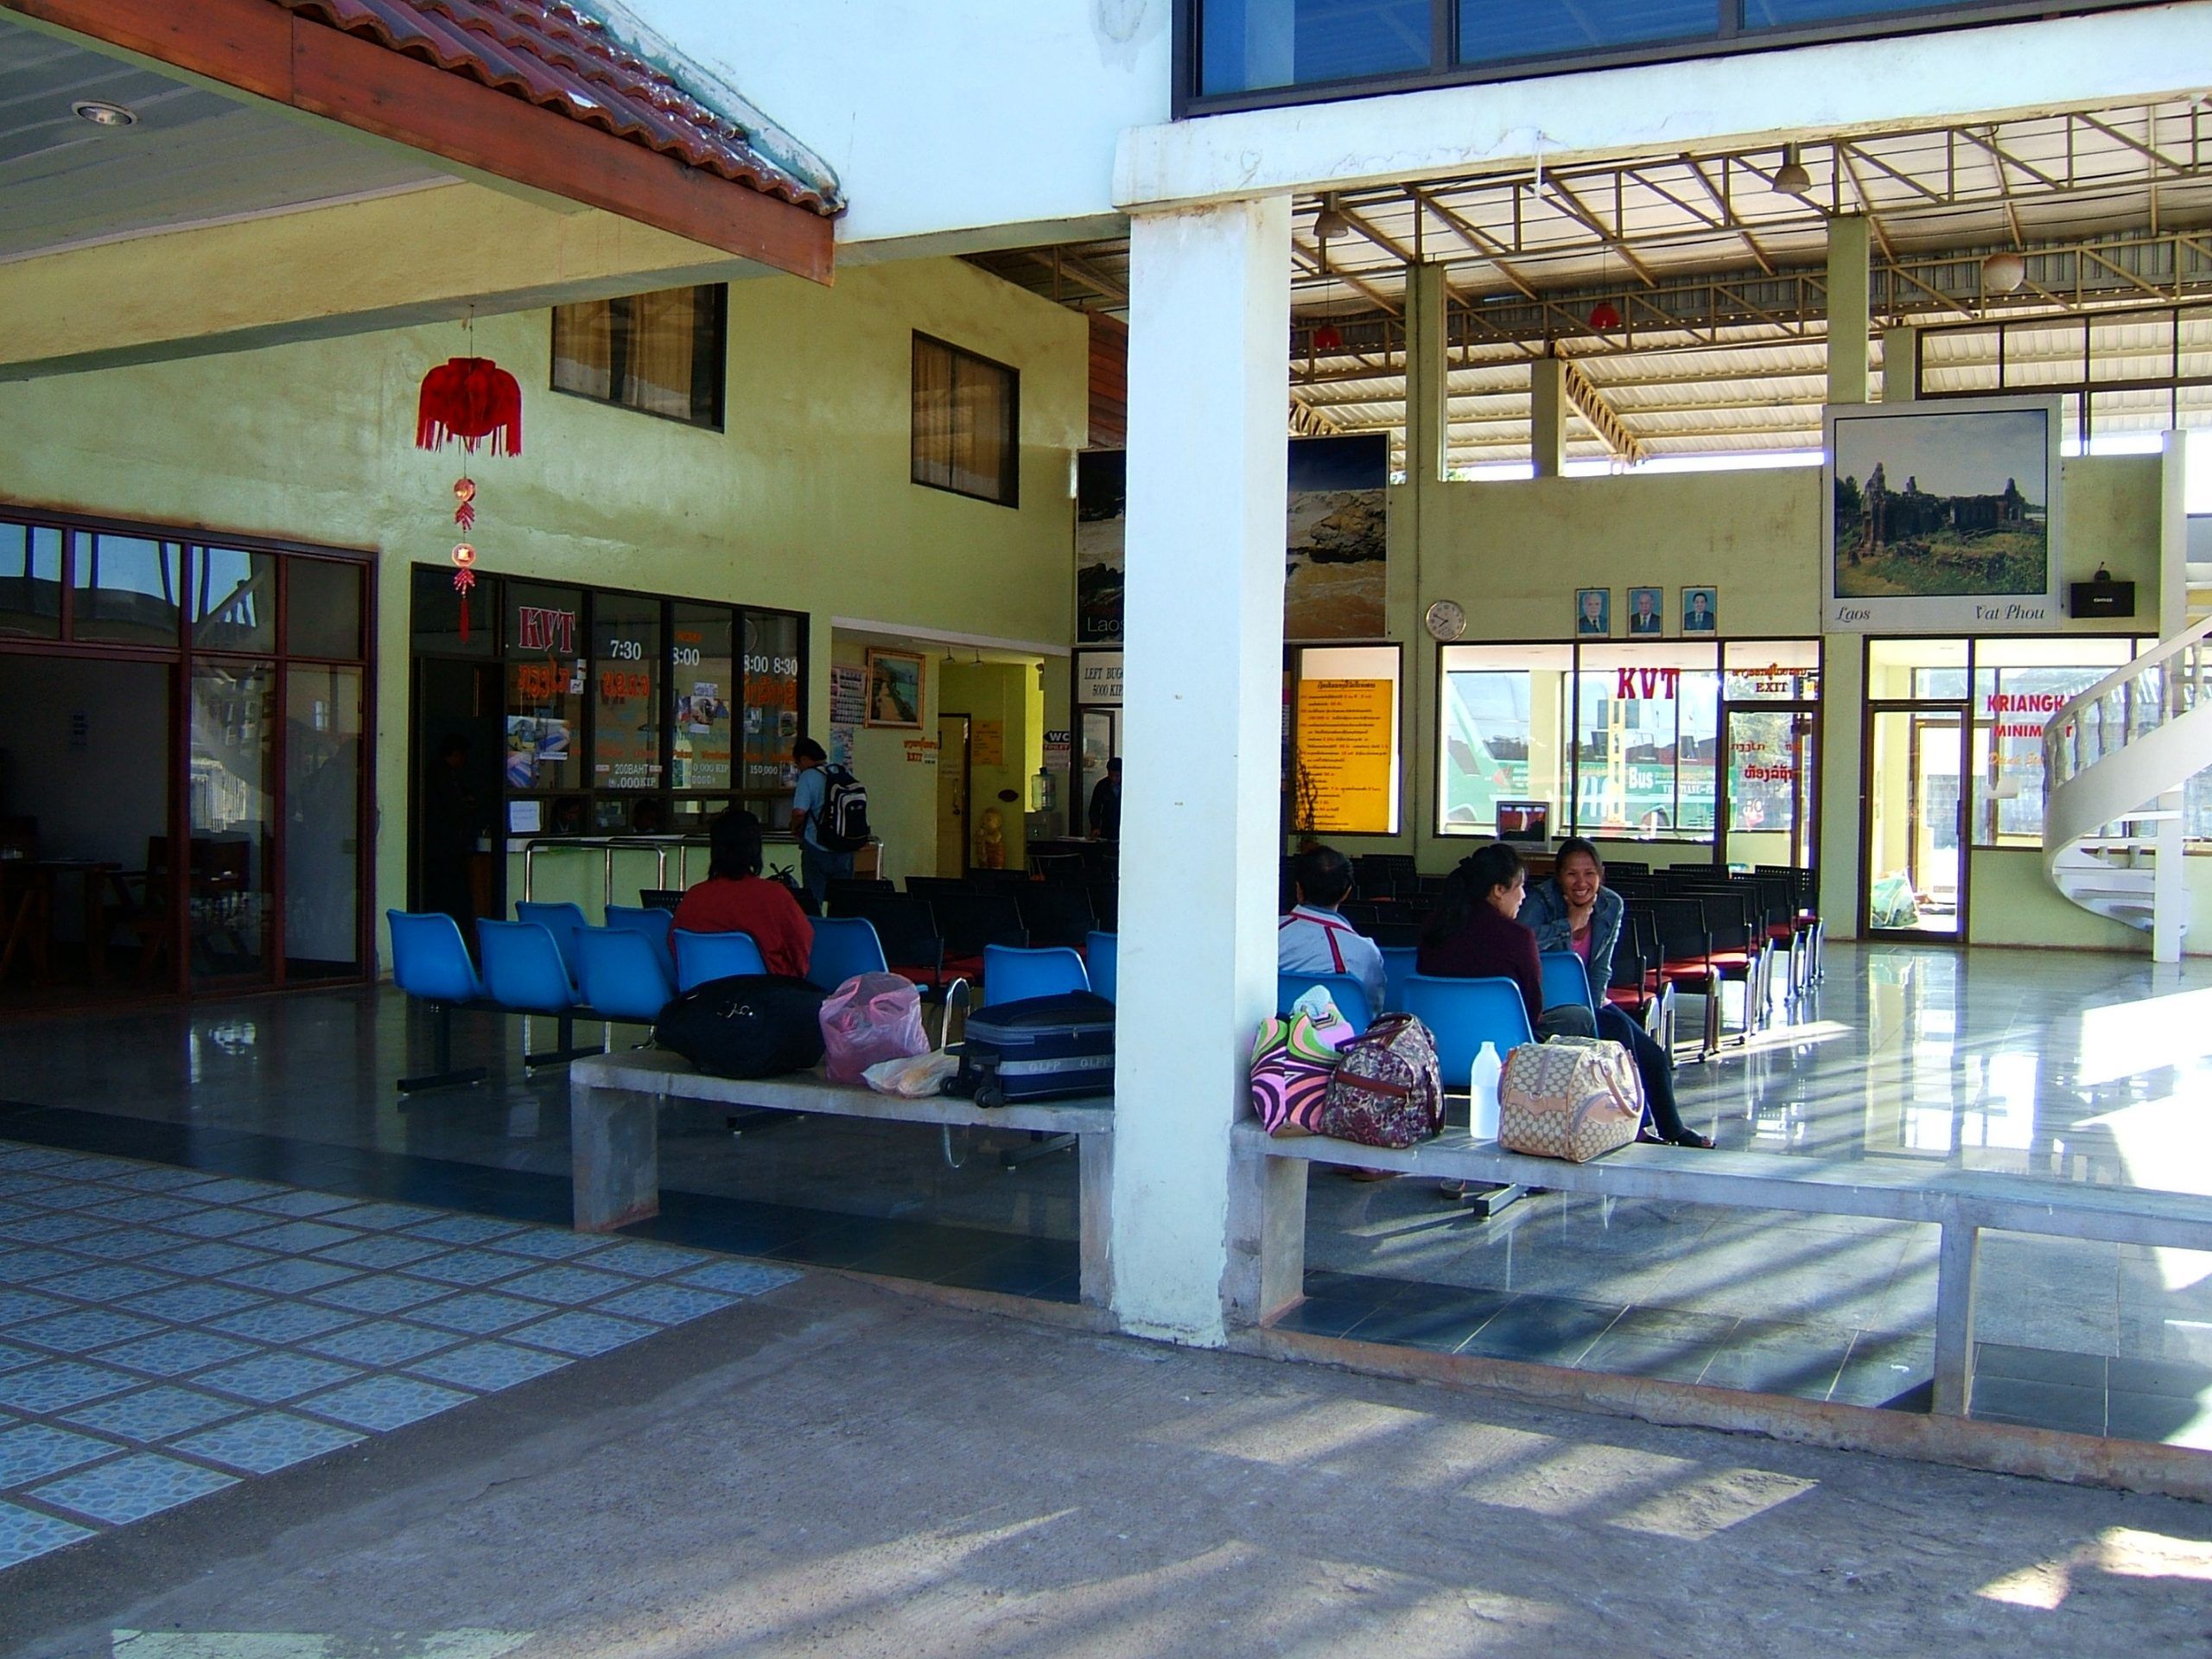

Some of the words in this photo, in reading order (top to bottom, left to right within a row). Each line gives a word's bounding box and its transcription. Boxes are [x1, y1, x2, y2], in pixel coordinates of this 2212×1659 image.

[1834, 607, 1871, 623] Laos
[1976, 605, 2000, 620] Vat
[2004, 604, 2045, 620] Phou
[518, 606, 576, 652] KVT
[610, 639, 642, 660] 7:30
[773, 657, 798, 677] 8:30
[1084, 668, 1103, 679] LEFT
[1106, 668, 1123, 679] BUG
[1092, 684, 1109, 696] 5000
[1618, 667, 1681, 699] KVT
[1755, 682, 1788, 692] EXIT
[1048, 731, 1070, 741] WC
[1628, 766, 1654, 790] Bus
